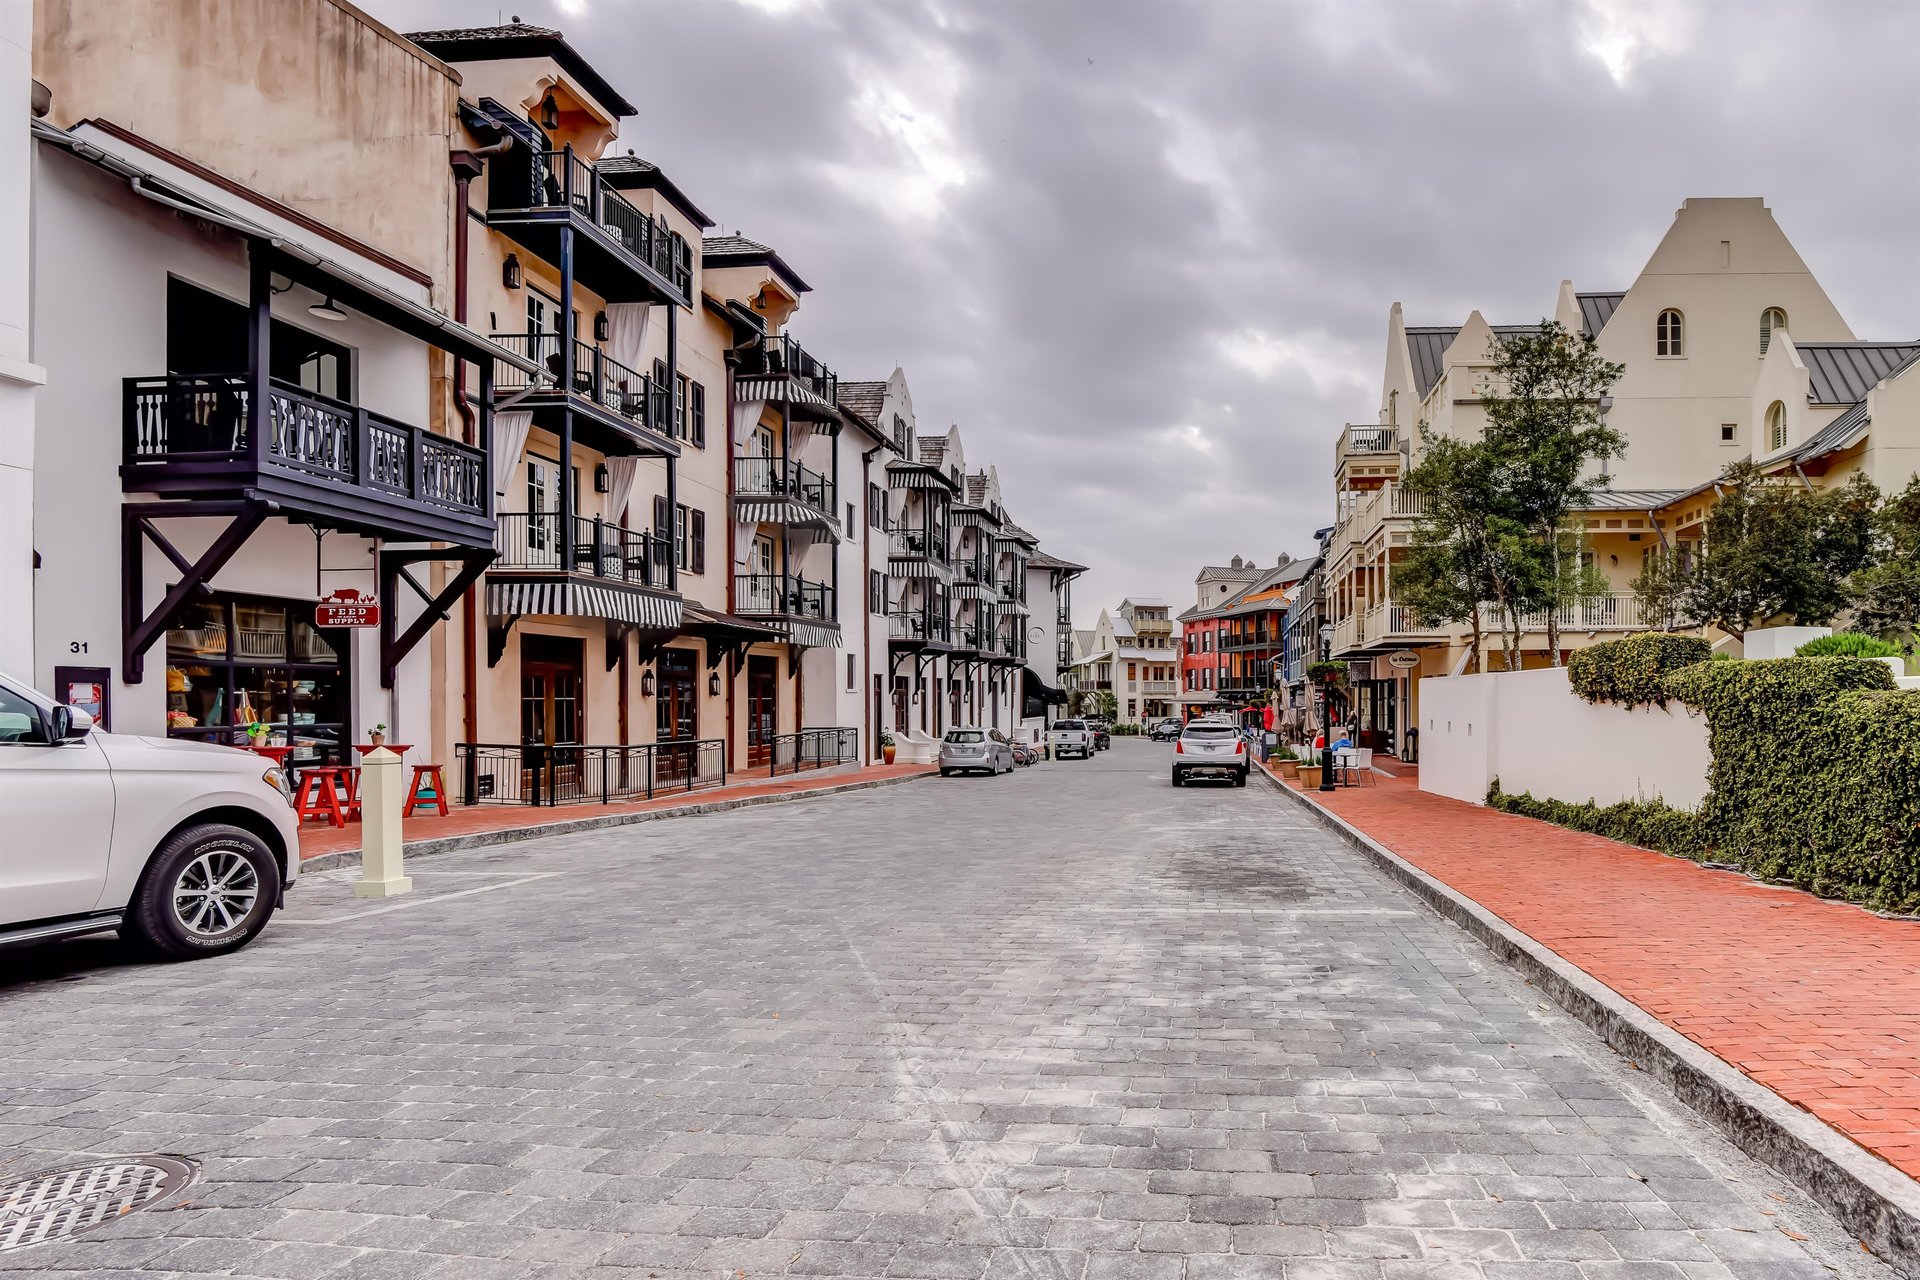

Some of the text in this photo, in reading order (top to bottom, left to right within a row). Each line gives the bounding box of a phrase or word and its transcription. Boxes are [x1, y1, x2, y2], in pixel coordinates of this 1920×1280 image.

[70, 642, 88, 654] 31
[194, 840, 254, 855] MICHELIN
[186, 928, 247, 945] MICHELIN
[4, 1187, 124, 1220] NITARY
